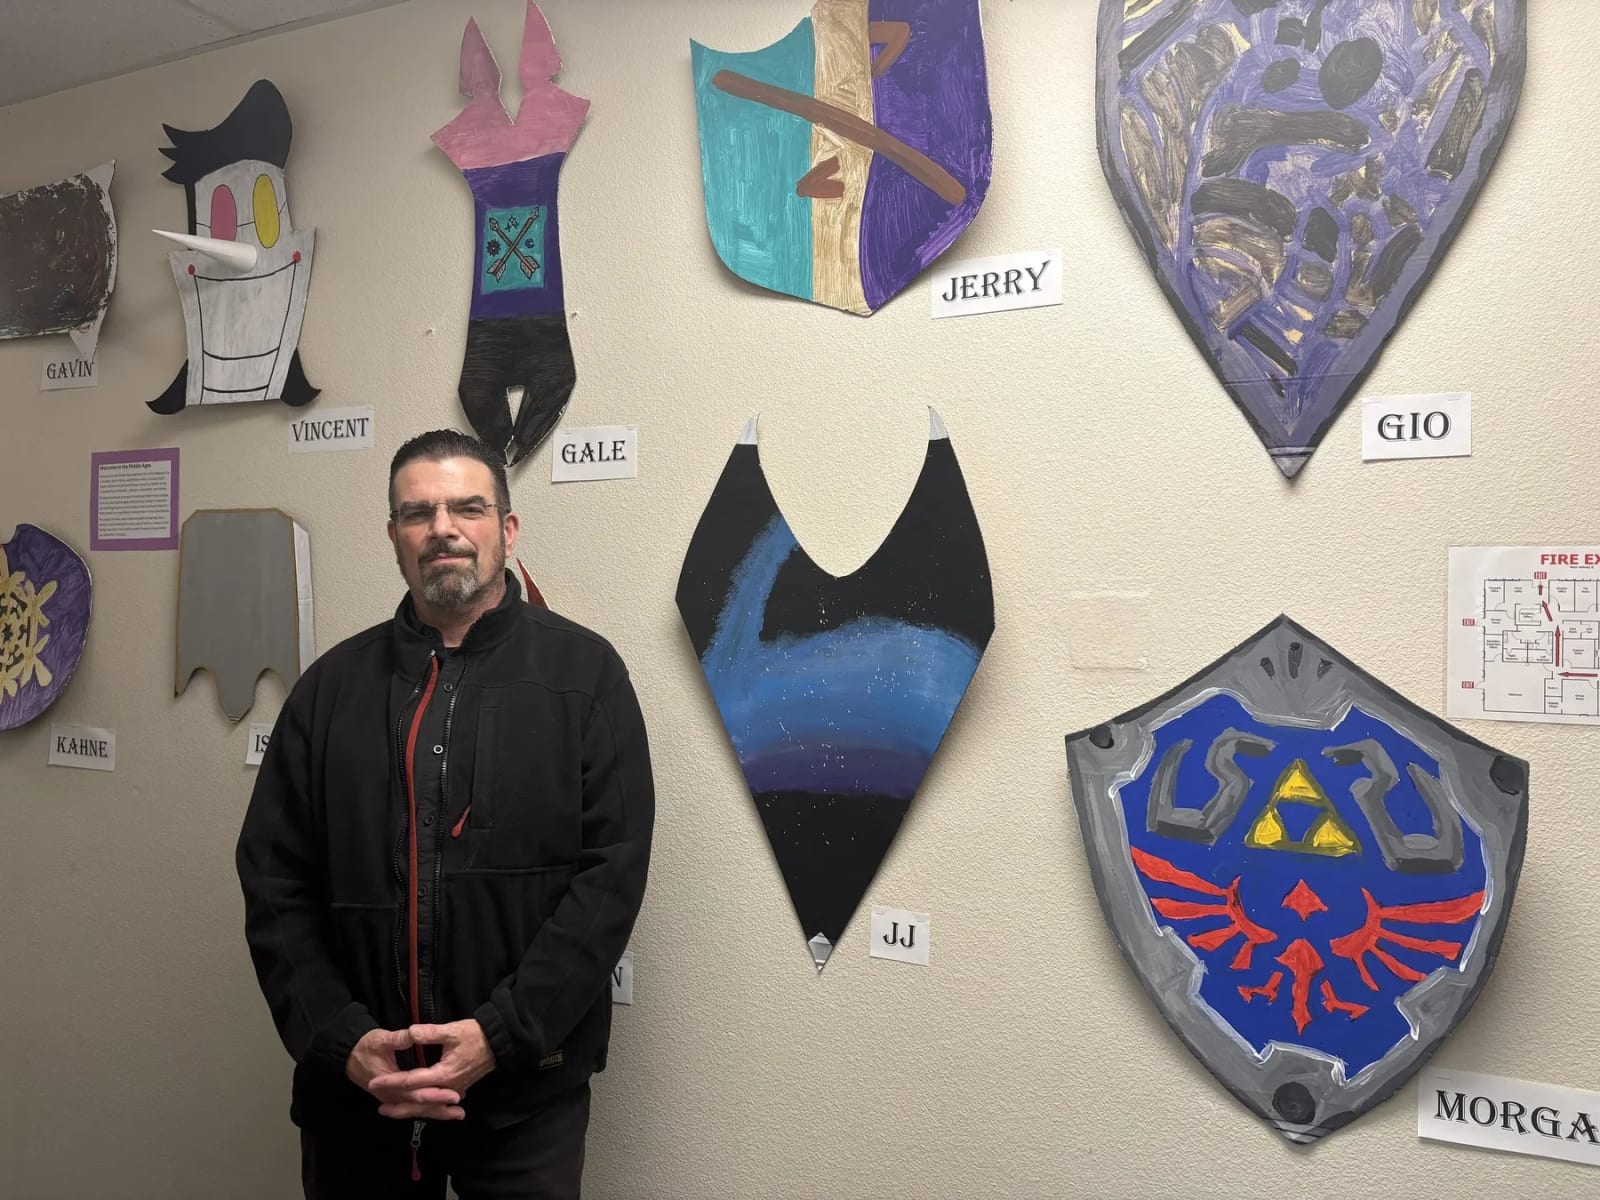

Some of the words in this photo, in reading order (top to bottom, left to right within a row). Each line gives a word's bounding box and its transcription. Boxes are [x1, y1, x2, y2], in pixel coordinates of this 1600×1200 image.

[942, 260, 1051, 302] JERRY
[46, 358, 95, 379] GAVIN
[291, 417, 369, 442] VINCENT
[1377, 411, 1452, 442] GIO
[561, 440, 626, 464] GALE
[1541, 554, 1579, 565] FIRE
[57, 736, 108, 758] KAHNE
[883, 921, 916, 949] JJ
[1434, 1089, 1600, 1146] MORGA
